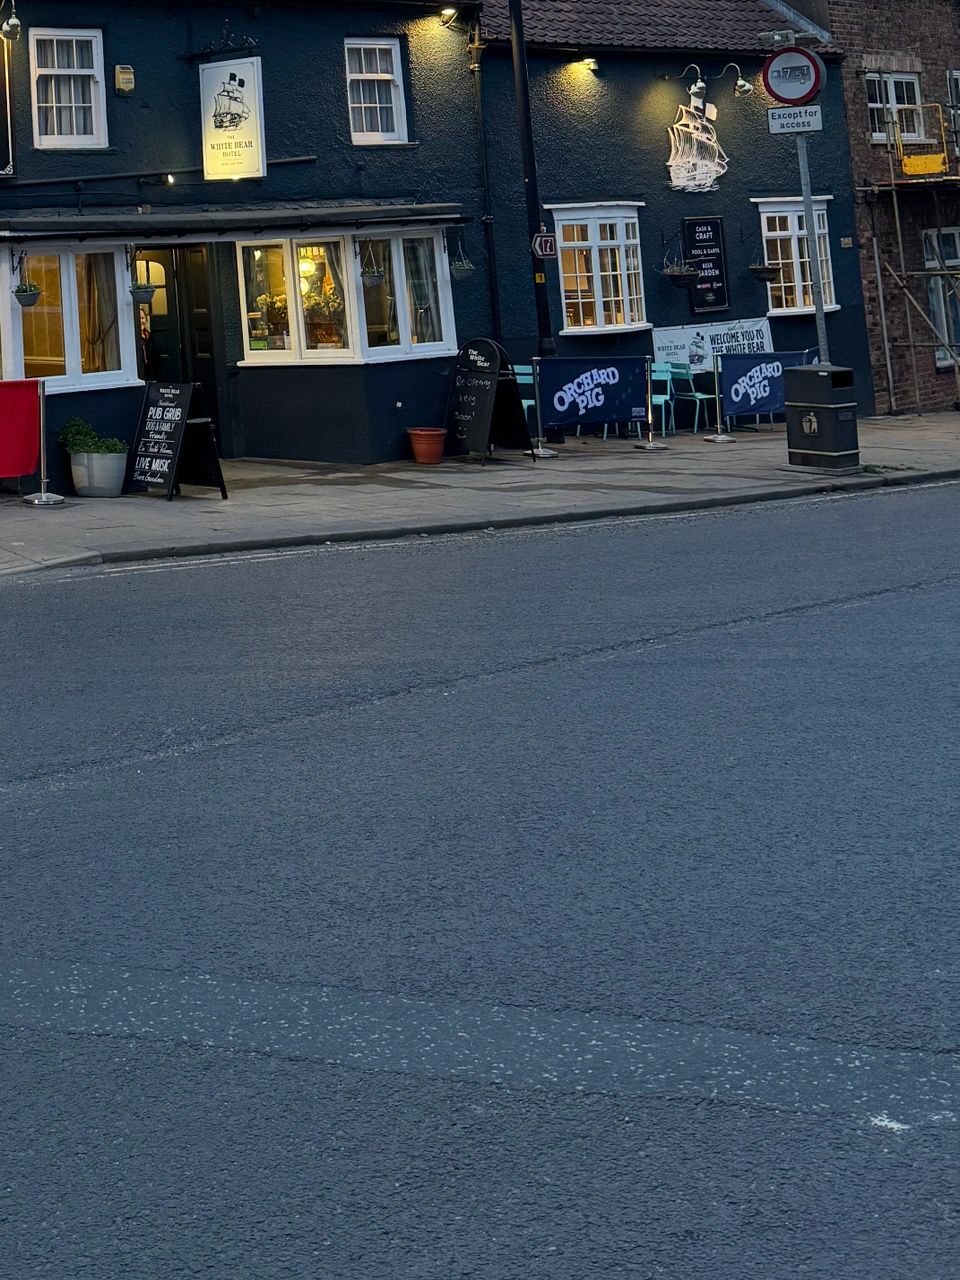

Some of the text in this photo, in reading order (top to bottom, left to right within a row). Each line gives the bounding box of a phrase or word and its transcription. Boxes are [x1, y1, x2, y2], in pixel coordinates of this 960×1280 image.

[771, 109, 818, 120] Except for
[780, 121, 811, 129] access
[210, 140, 253, 151] WHITE BEAR
[695, 232, 713, 240] CRAFT
[709, 329, 765, 346] WELCOME YOU TO
[712, 341, 766, 354] THE WHITE BEAR
[731, 361, 782, 402] ORCHARD
[554, 367, 619, 412] ORCHARD
[748, 380, 770, 405] PIG
[575, 387, 604, 415] PIG
[147, 407, 182, 421] PUB GRUB
[159, 422, 175, 432] FAMILY
[135, 457, 171, 472] LIVE MUSIC
